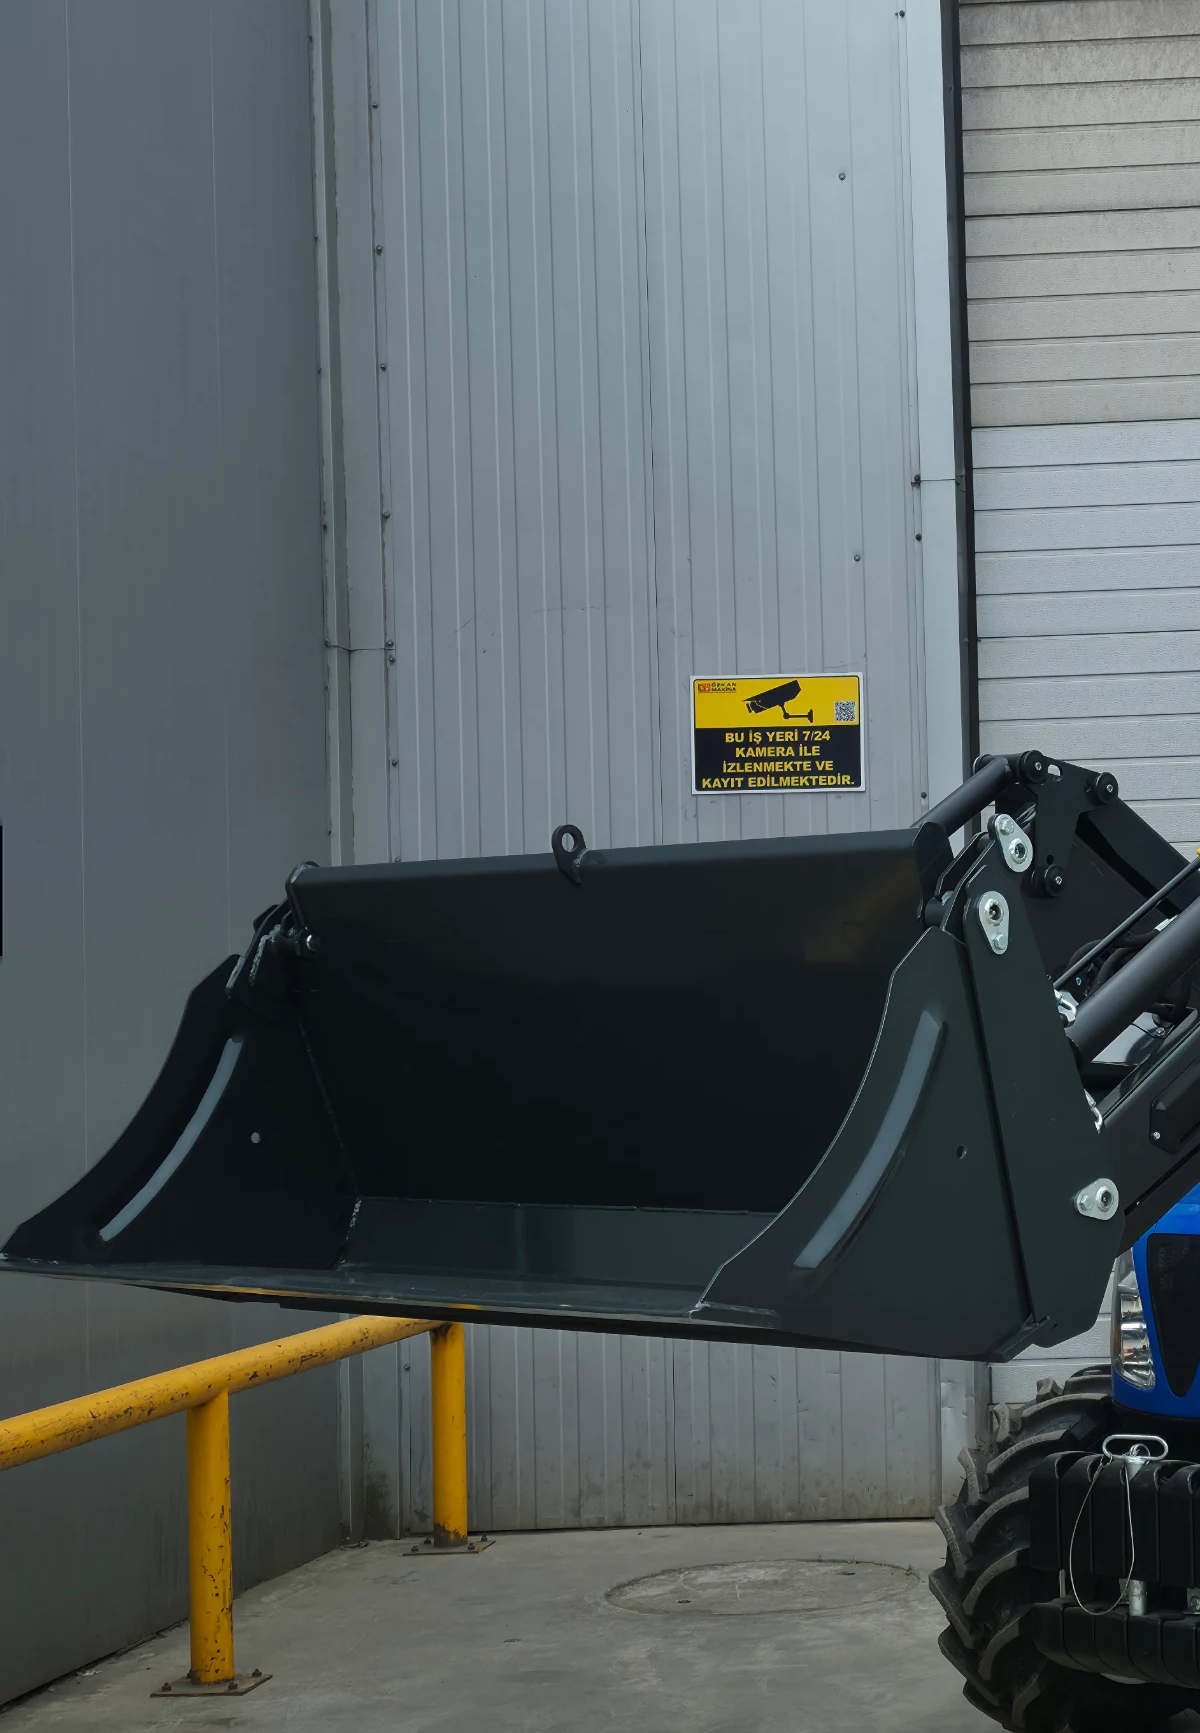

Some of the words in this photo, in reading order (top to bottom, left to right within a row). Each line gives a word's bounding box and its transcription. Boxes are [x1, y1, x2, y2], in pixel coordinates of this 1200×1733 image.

[725, 732, 745, 743] BU
[749, 729, 762, 745] İŞ
[766, 729, 799, 743] YERİ
[803, 730, 831, 741] 7/24
[735, 746, 795, 758] KAMERA
[799, 744, 821, 757] İLE
[722, 760, 812, 774] İZLENMEKTE
[815, 760, 834, 772] VE
[702, 777, 744, 789] KAYIT
[748, 773, 855, 788] EDİLMEKTEDİR.
